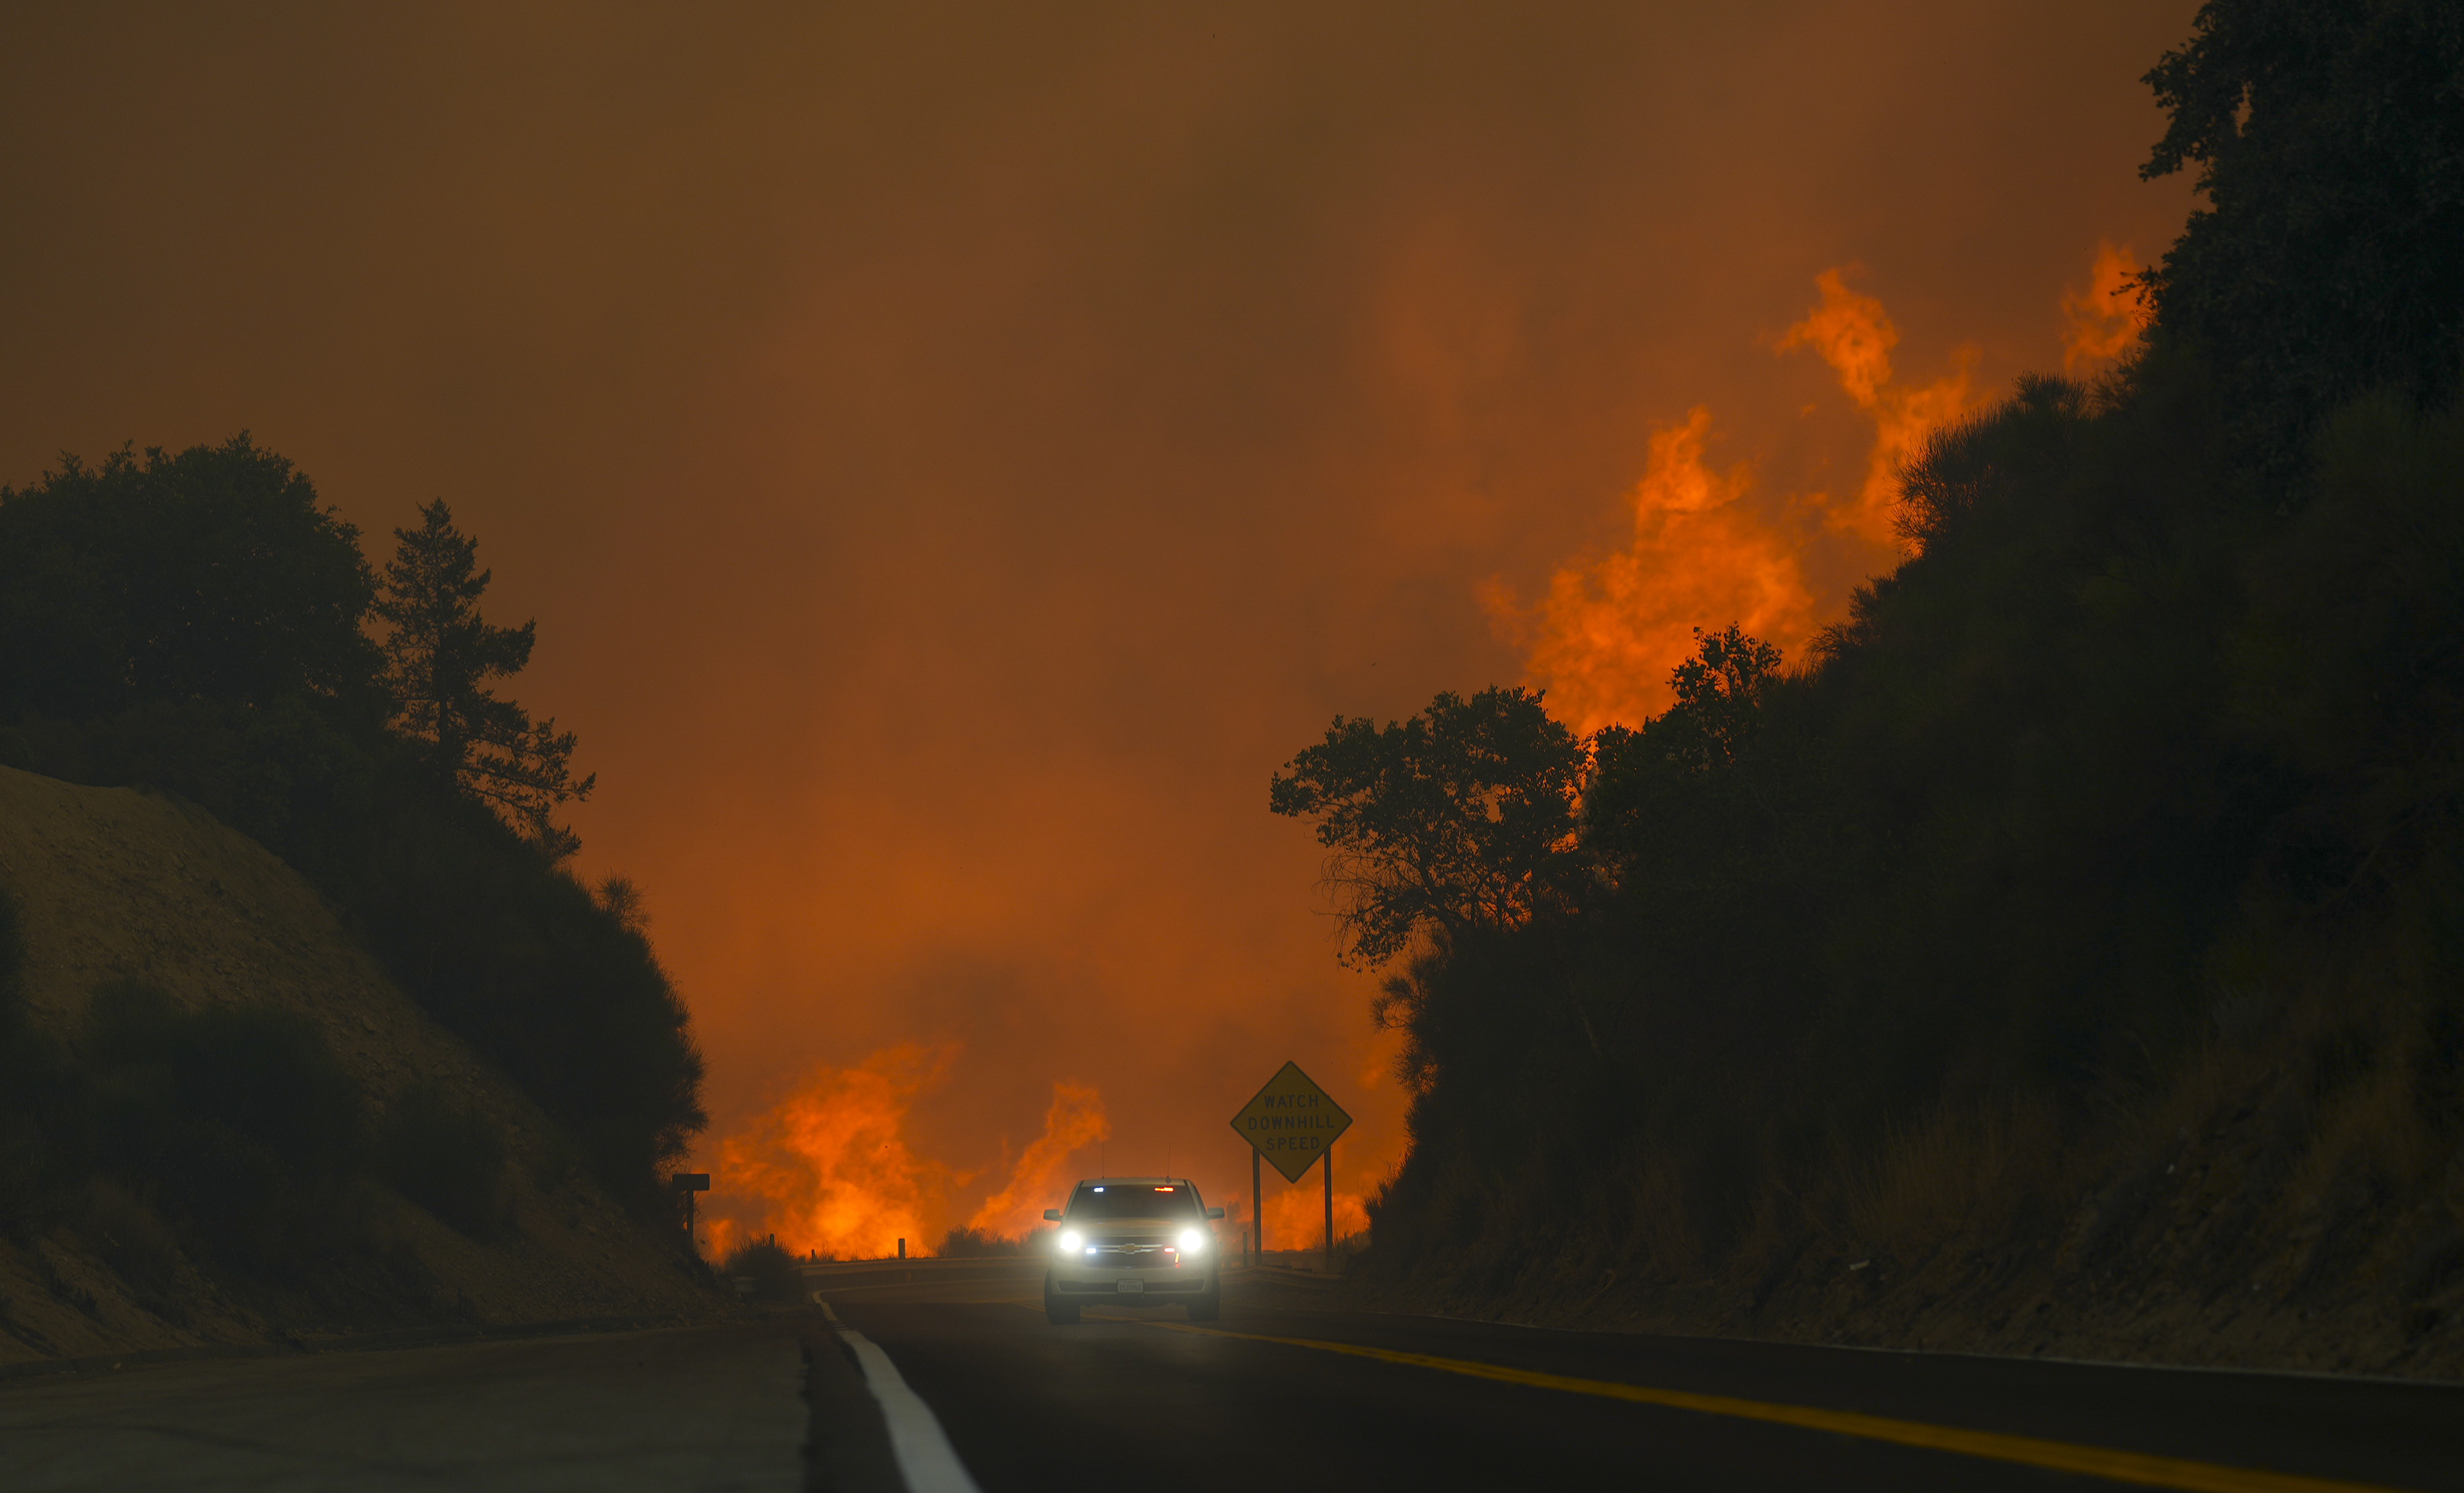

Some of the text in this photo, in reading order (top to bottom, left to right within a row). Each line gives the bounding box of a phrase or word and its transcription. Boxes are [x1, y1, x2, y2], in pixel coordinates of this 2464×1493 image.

[1264, 1094, 1319, 1108] WATCH
[1248, 1115, 1335, 1130] DOWNHILL
[1266, 1136, 1320, 1151] SPEED
